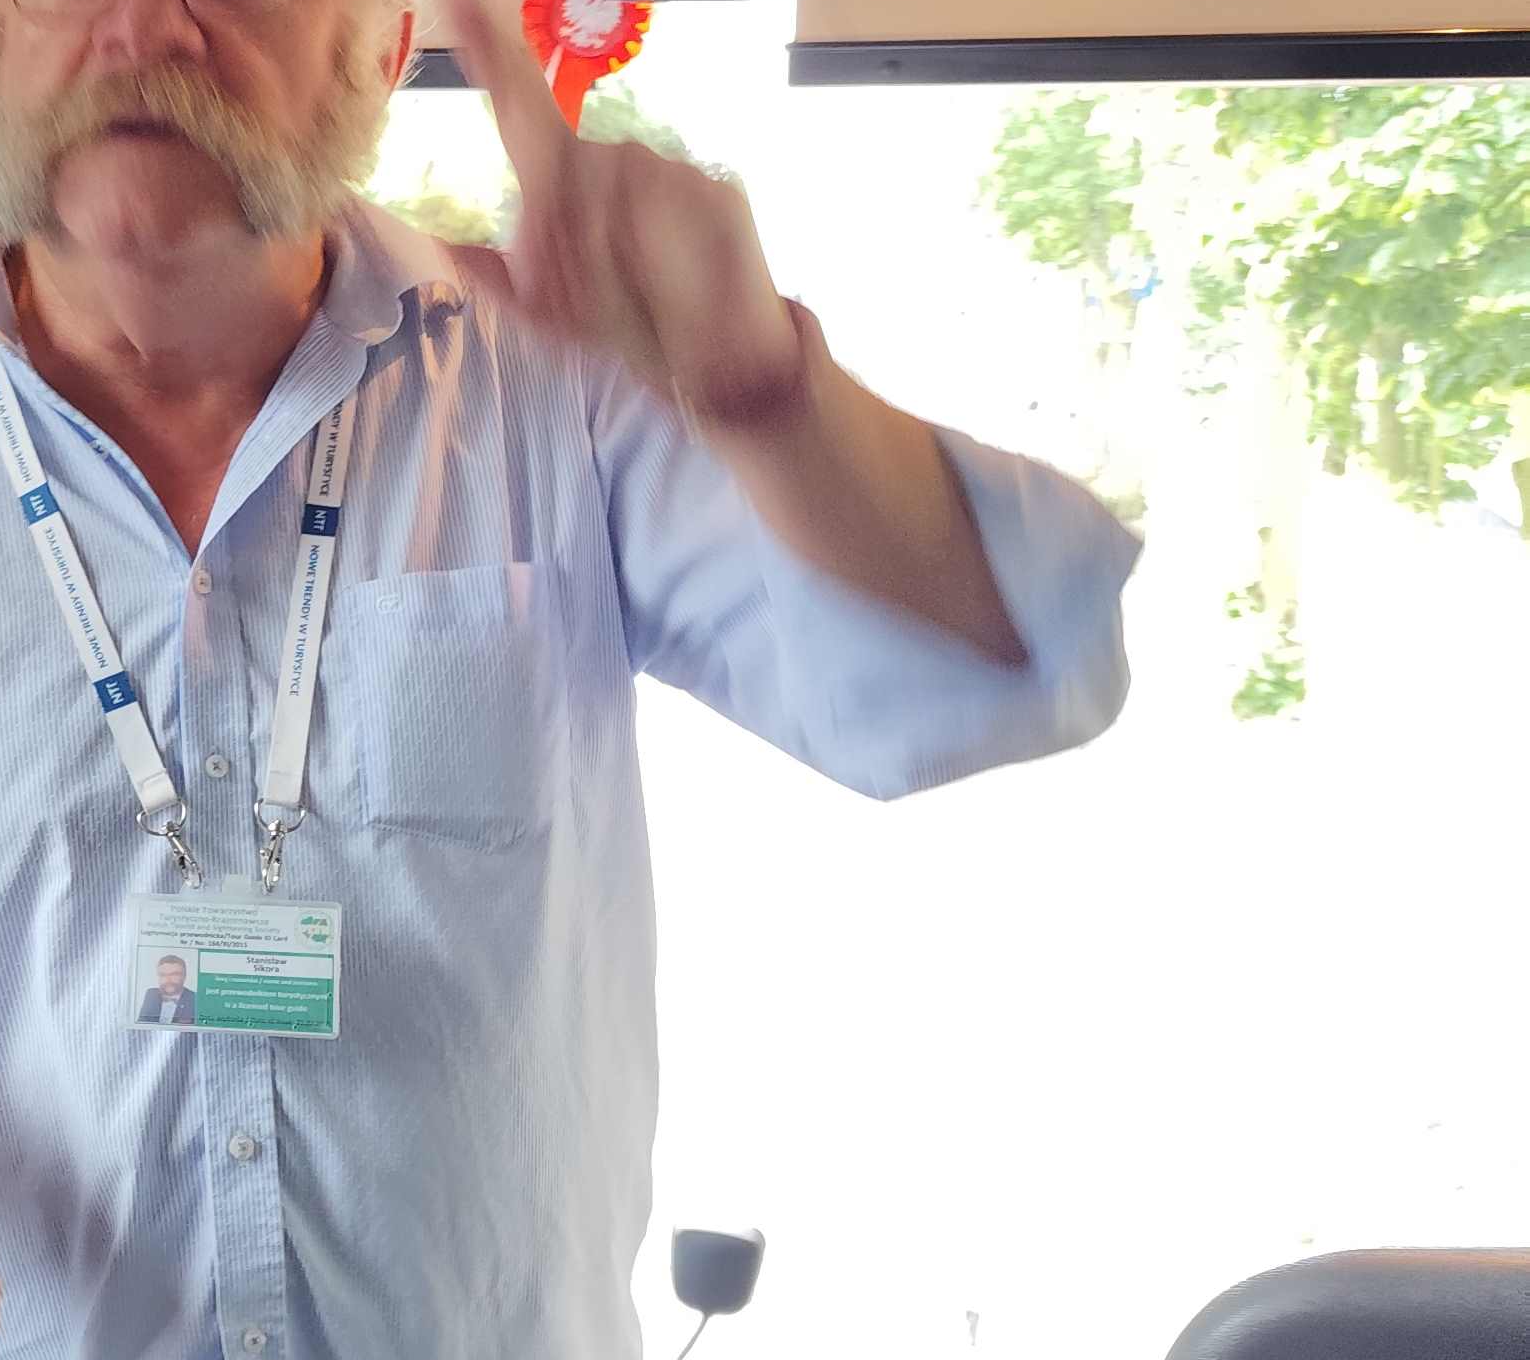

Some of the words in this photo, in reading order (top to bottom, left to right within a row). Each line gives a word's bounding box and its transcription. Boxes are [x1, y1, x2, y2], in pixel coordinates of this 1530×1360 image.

[306, 544, 320, 578] NOWE
[65, 582, 75, 593] W
[299, 579, 316, 621] TRENDY
[70, 594, 94, 634] TRENDY
[297, 623, 308, 635] W
[88, 637, 109, 669] NOWE
